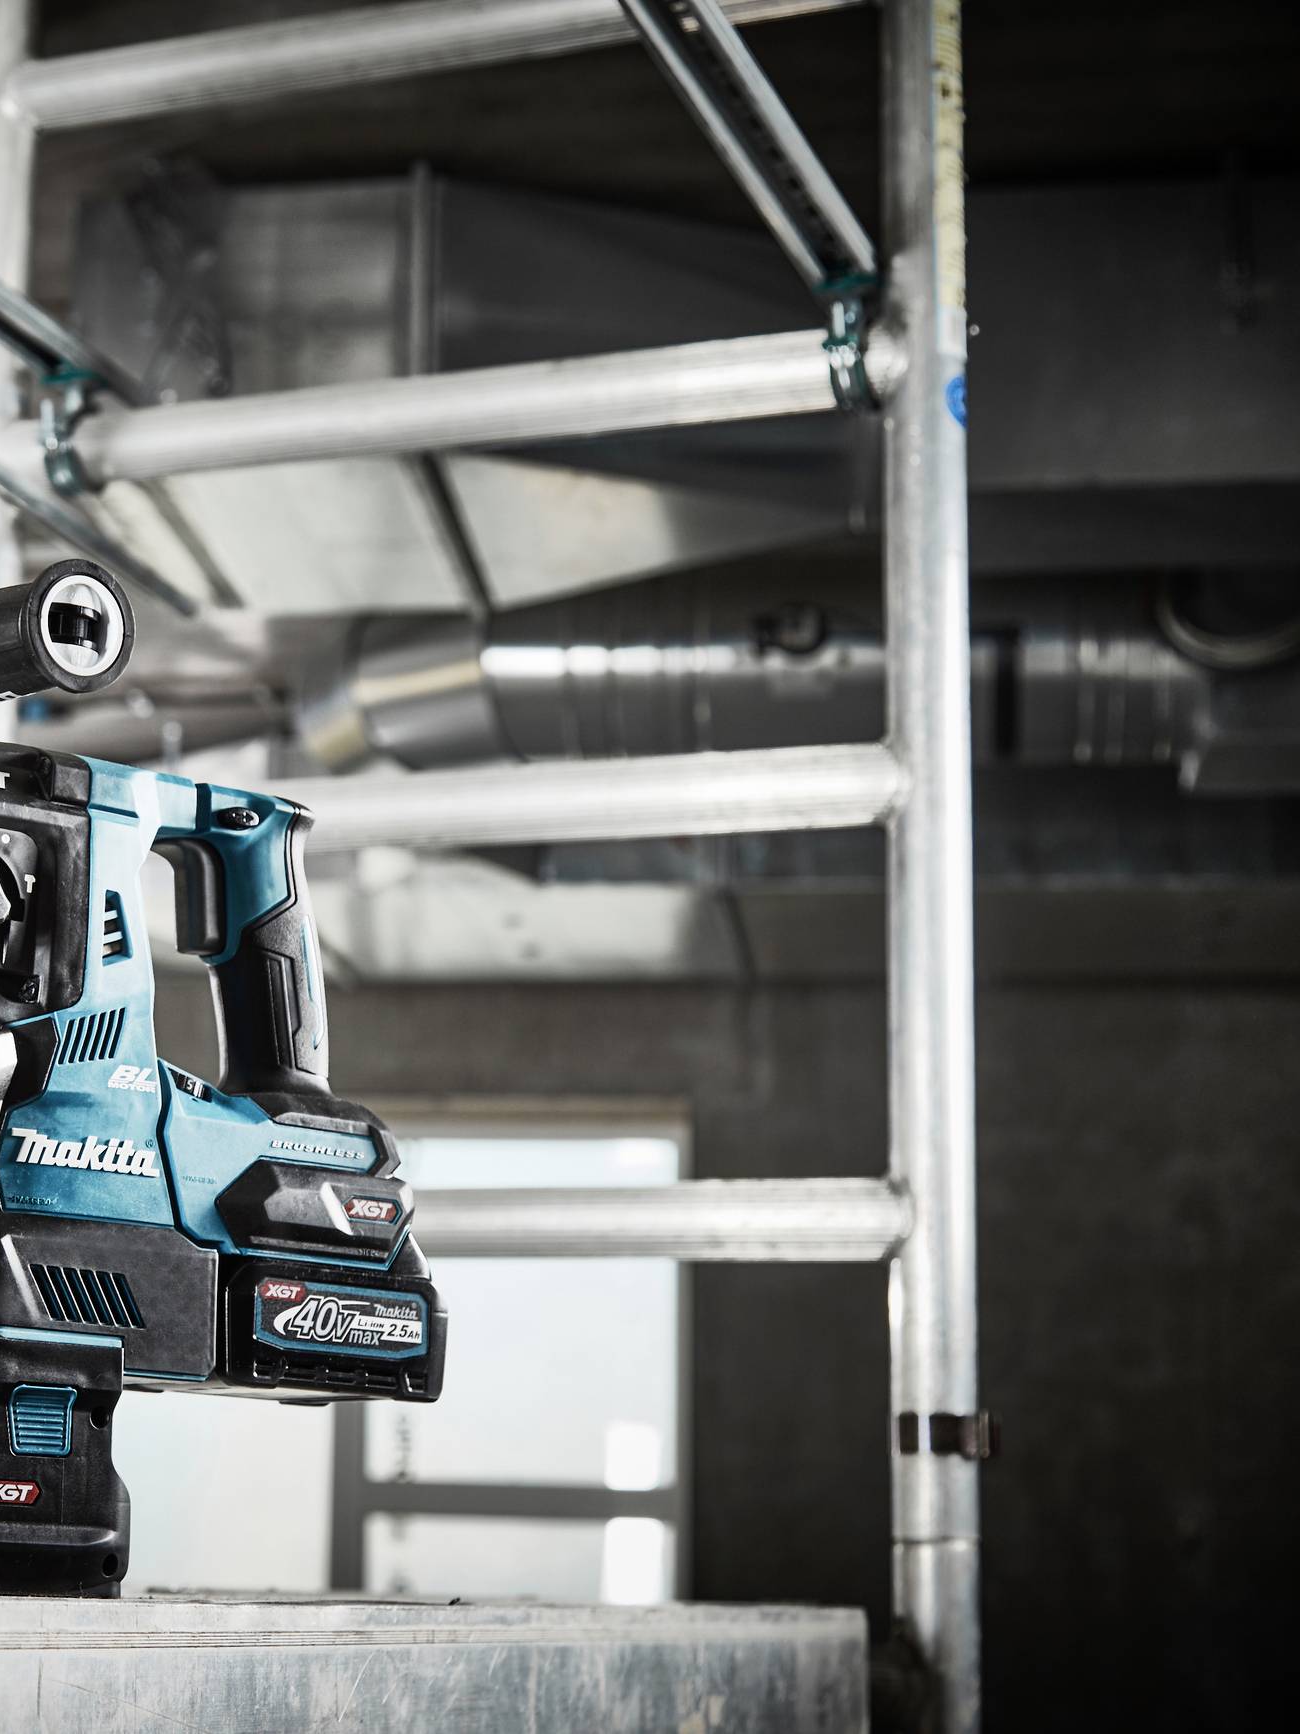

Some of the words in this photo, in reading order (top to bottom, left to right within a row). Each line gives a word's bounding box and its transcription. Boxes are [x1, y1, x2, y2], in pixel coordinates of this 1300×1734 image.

[109, 1064, 157, 1084] BL
[271, 1140, 365, 1160] BRUSHLESS
[348, 1198, 394, 1219] XGT
[264, 1283, 302, 1300] XGT
[348, 1329, 382, 1346] max
